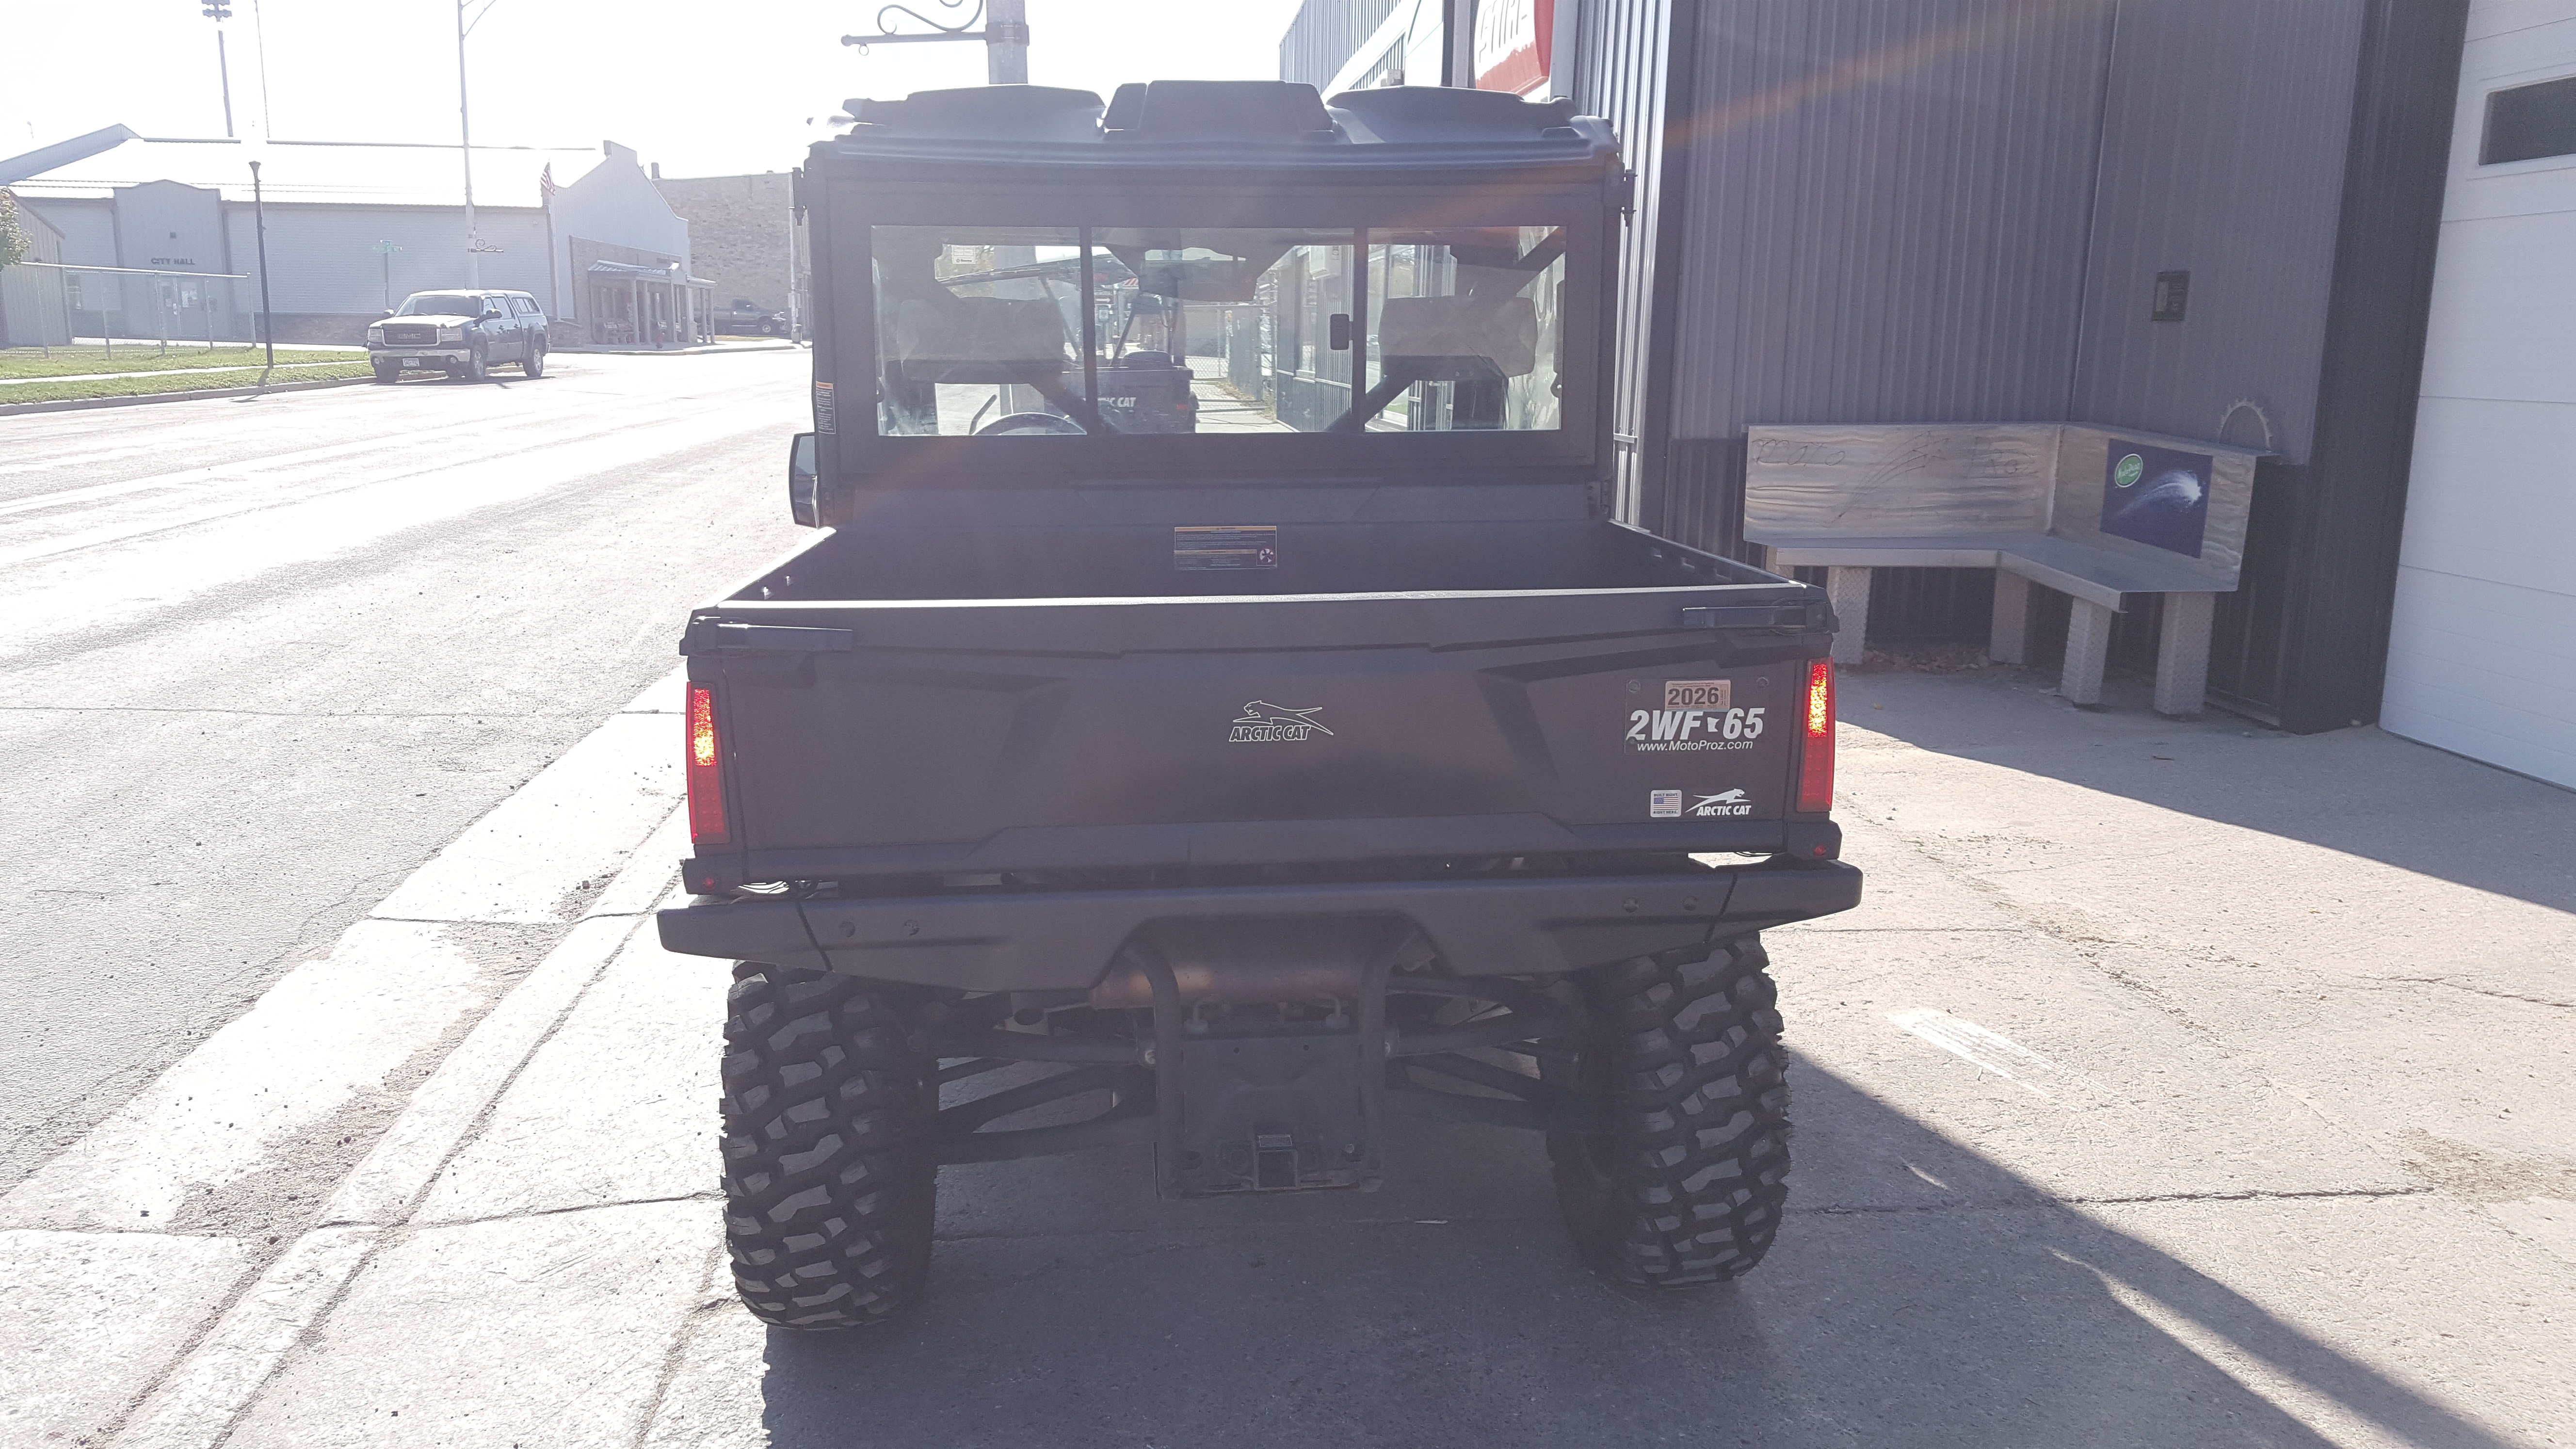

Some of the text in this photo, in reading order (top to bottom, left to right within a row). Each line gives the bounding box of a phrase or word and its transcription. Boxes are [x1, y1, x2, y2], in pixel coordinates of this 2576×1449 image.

[1117, 397, 1136, 407] CAT
[1668, 687, 1719, 706] 2026
[1626, 708, 1766, 741] 2WF 65
[1228, 725, 1311, 742] ARCTIC CAT
[1637, 740, 1754, 751] www.MotoProz.com
[1696, 805, 1752, 816] ARCTIC CAT
